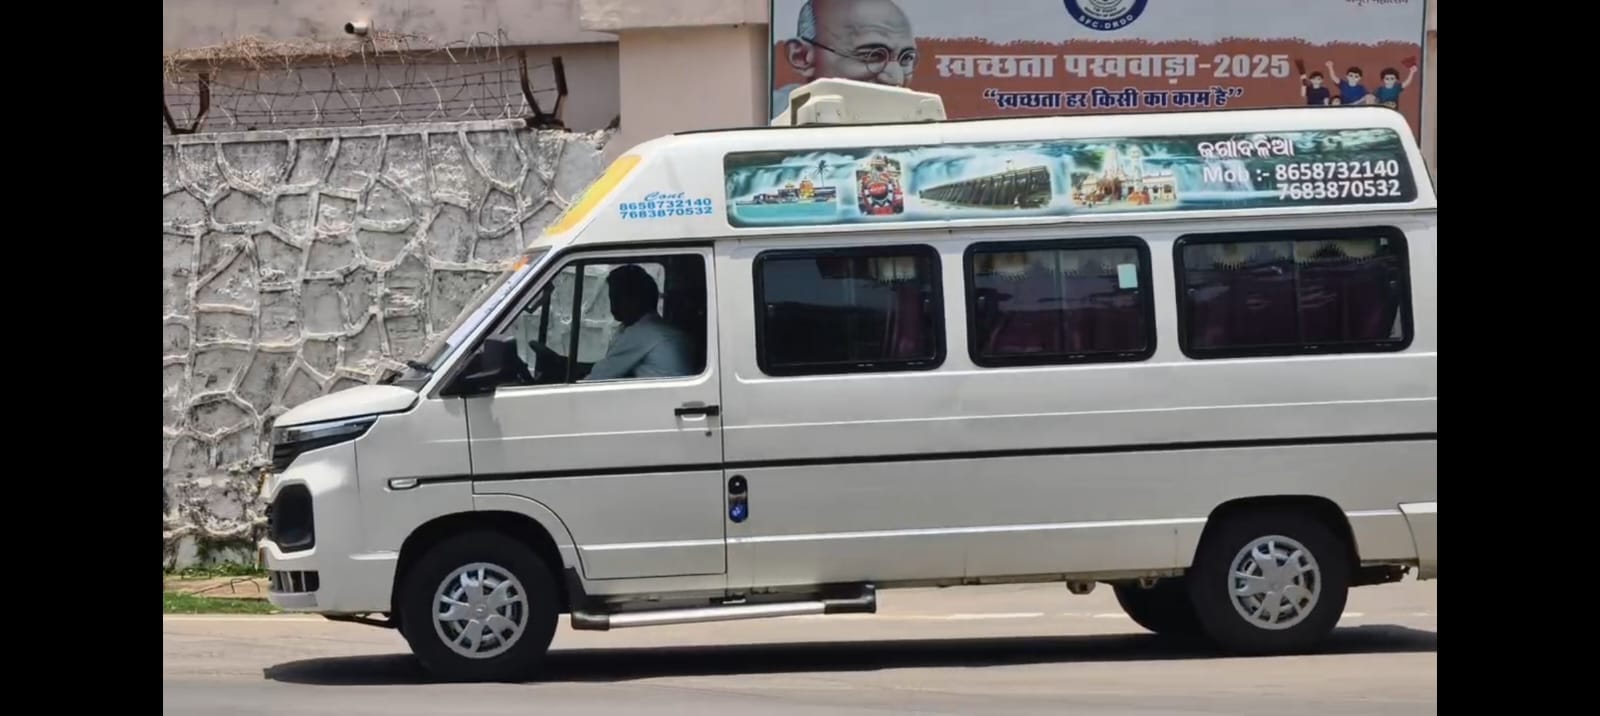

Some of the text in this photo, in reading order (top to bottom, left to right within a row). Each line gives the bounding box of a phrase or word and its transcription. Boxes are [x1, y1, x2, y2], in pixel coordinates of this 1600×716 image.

[935, 54, 1290, 84] स्वच्छता पखवाड़ा-2025
[1066, 91, 1088, 108] हर
[1091, 88, 1138, 108] किसी
[1144, 90, 1168, 107] का
[1173, 89, 1211, 107] काम
[1203, 165, 1249, 184] Mob
[1275, 160, 1399, 181] 8658732140
[1276, 179, 1401, 200] 7683870532
[619, 198, 712, 211] 8658732140
[620, 206, 713, 219] 7683870532
